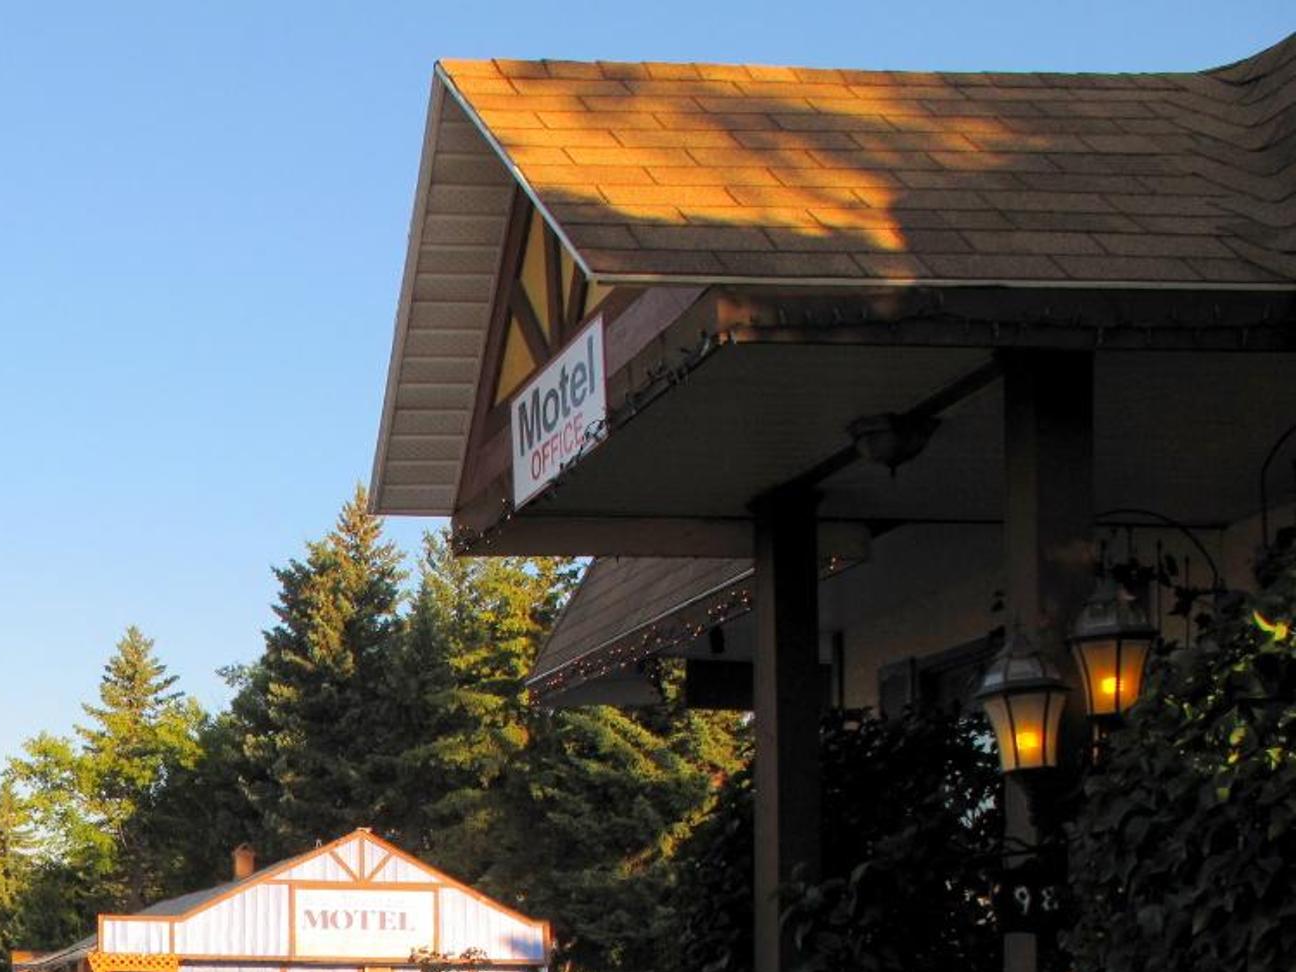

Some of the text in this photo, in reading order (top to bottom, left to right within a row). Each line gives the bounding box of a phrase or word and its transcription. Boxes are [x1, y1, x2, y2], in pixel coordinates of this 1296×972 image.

[519, 337, 595, 455] Motel
[531, 414, 586, 480] OFFICE
[303, 909, 416, 931] MOTEL
